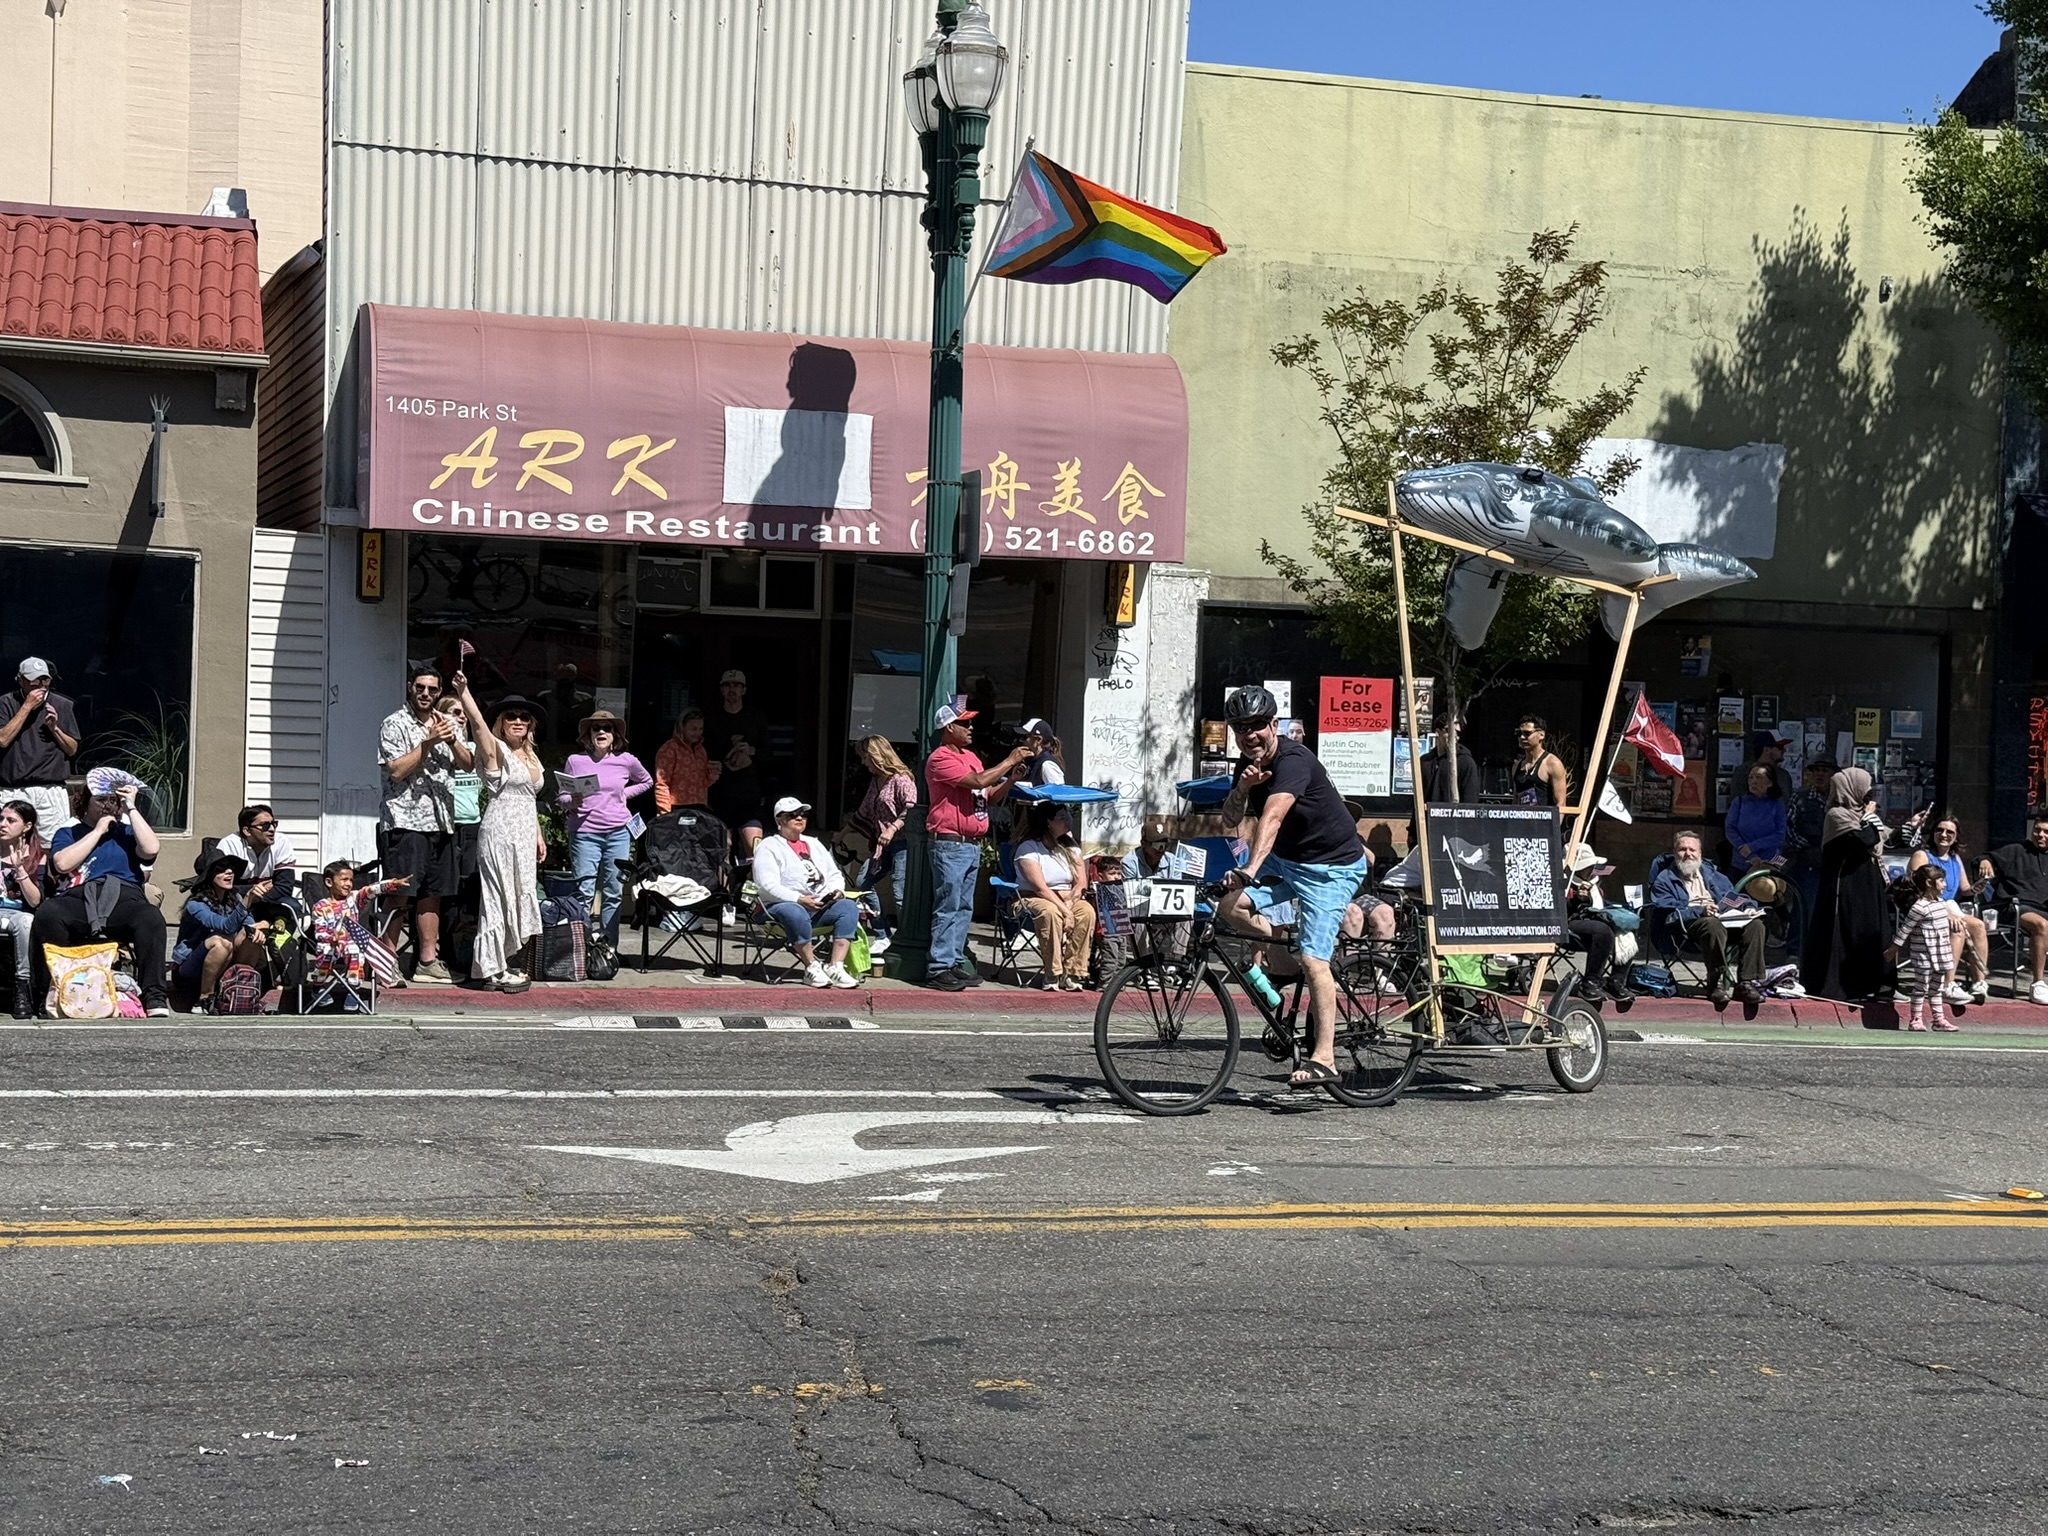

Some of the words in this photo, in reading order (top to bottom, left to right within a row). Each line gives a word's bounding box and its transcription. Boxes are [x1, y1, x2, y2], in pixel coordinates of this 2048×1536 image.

[385, 395, 436, 417] 1405
[442, 399, 490, 421] Park
[495, 403, 518, 422] St
[429, 425, 677, 501] ARK
[411, 498, 609, 534] Chinese
[625, 510, 881, 546] Restaurant
[1004, 525, 1155, 556] 521-6862
[365, 538, 379, 590] ARK
[1341, 680, 1372, 695] For
[1330, 697, 1382, 713] Lease
[1323, 716, 1388, 729] 415.395.7262
[1858, 711, 1876, 719] IMP
[1322, 739, 1346, 749] Justin
[1348, 740, 1367, 749] Choi
[1338, 761, 1381, 769] Badstubner
[1376, 785, 1388, 793] JLL
[1430, 808, 1452, 817] DIRECT
[1453, 808, 1476, 818] ACTION
[1476, 810, 1488, 818] FOR
[1489, 810, 1509, 819] OCEAN
[1509, 811, 1552, 820] CONSERVATION
[1160, 888, 1185, 911] 75
[1464, 890, 1499, 909] Watson
